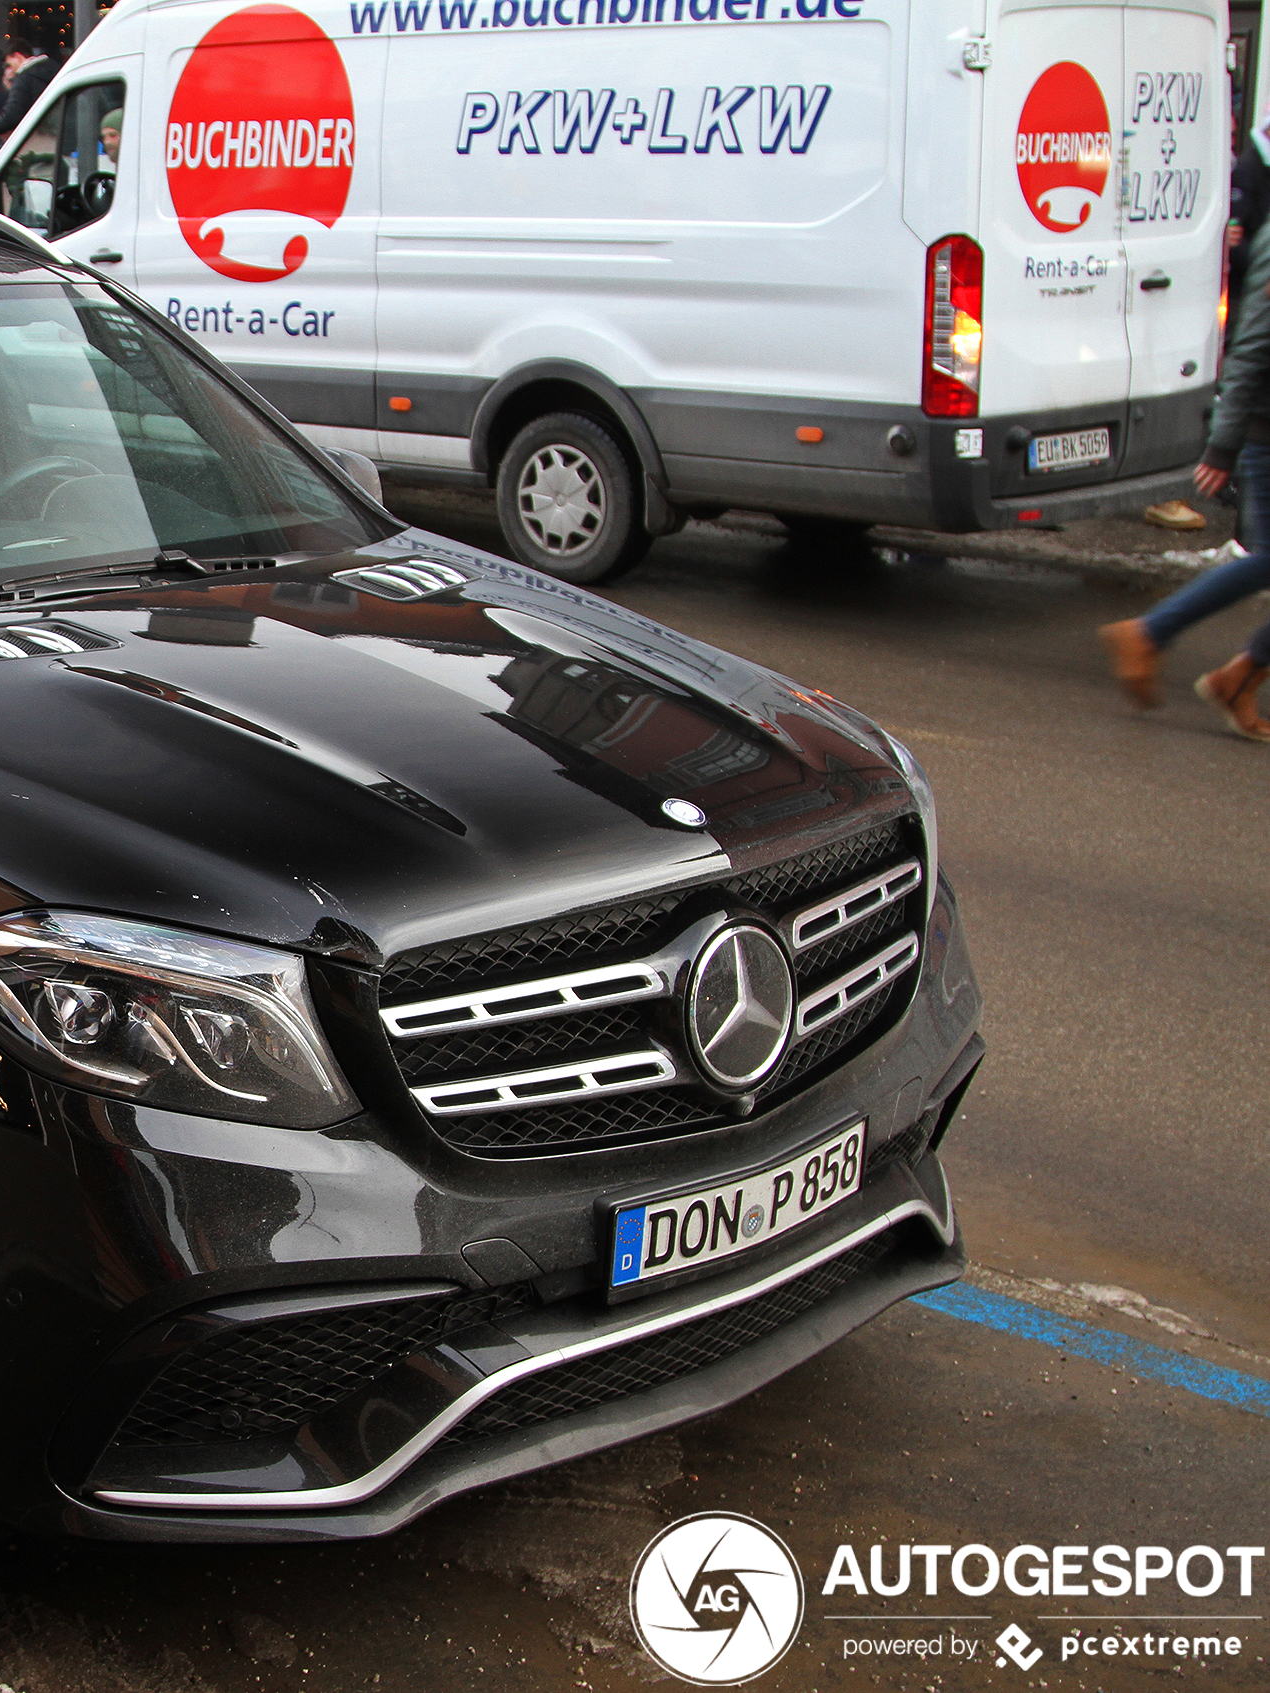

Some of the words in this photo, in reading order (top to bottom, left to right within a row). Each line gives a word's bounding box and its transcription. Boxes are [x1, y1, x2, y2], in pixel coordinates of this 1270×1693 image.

[456, 83, 833, 155] PKW+LKW
[1132, 71, 1203, 123] PKW
[166, 118, 354, 169] BUCHBINDER
[1016, 131, 1112, 165] BUCHBINDER
[1128, 168, 1201, 222] LKW
[1025, 254, 1110, 279] Rent-a-Car
[166, 296, 336, 338] Rent-a-Car
[1037, 440, 1055, 464] EU
[1062, 435, 1078, 460] BK
[1079, 431, 1108, 457] 5059
[644, 1188, 743, 1270] DON
[769, 1170, 795, 1230] P
[800, 1132, 860, 1213] 858
[620, 1252, 634, 1272] D
